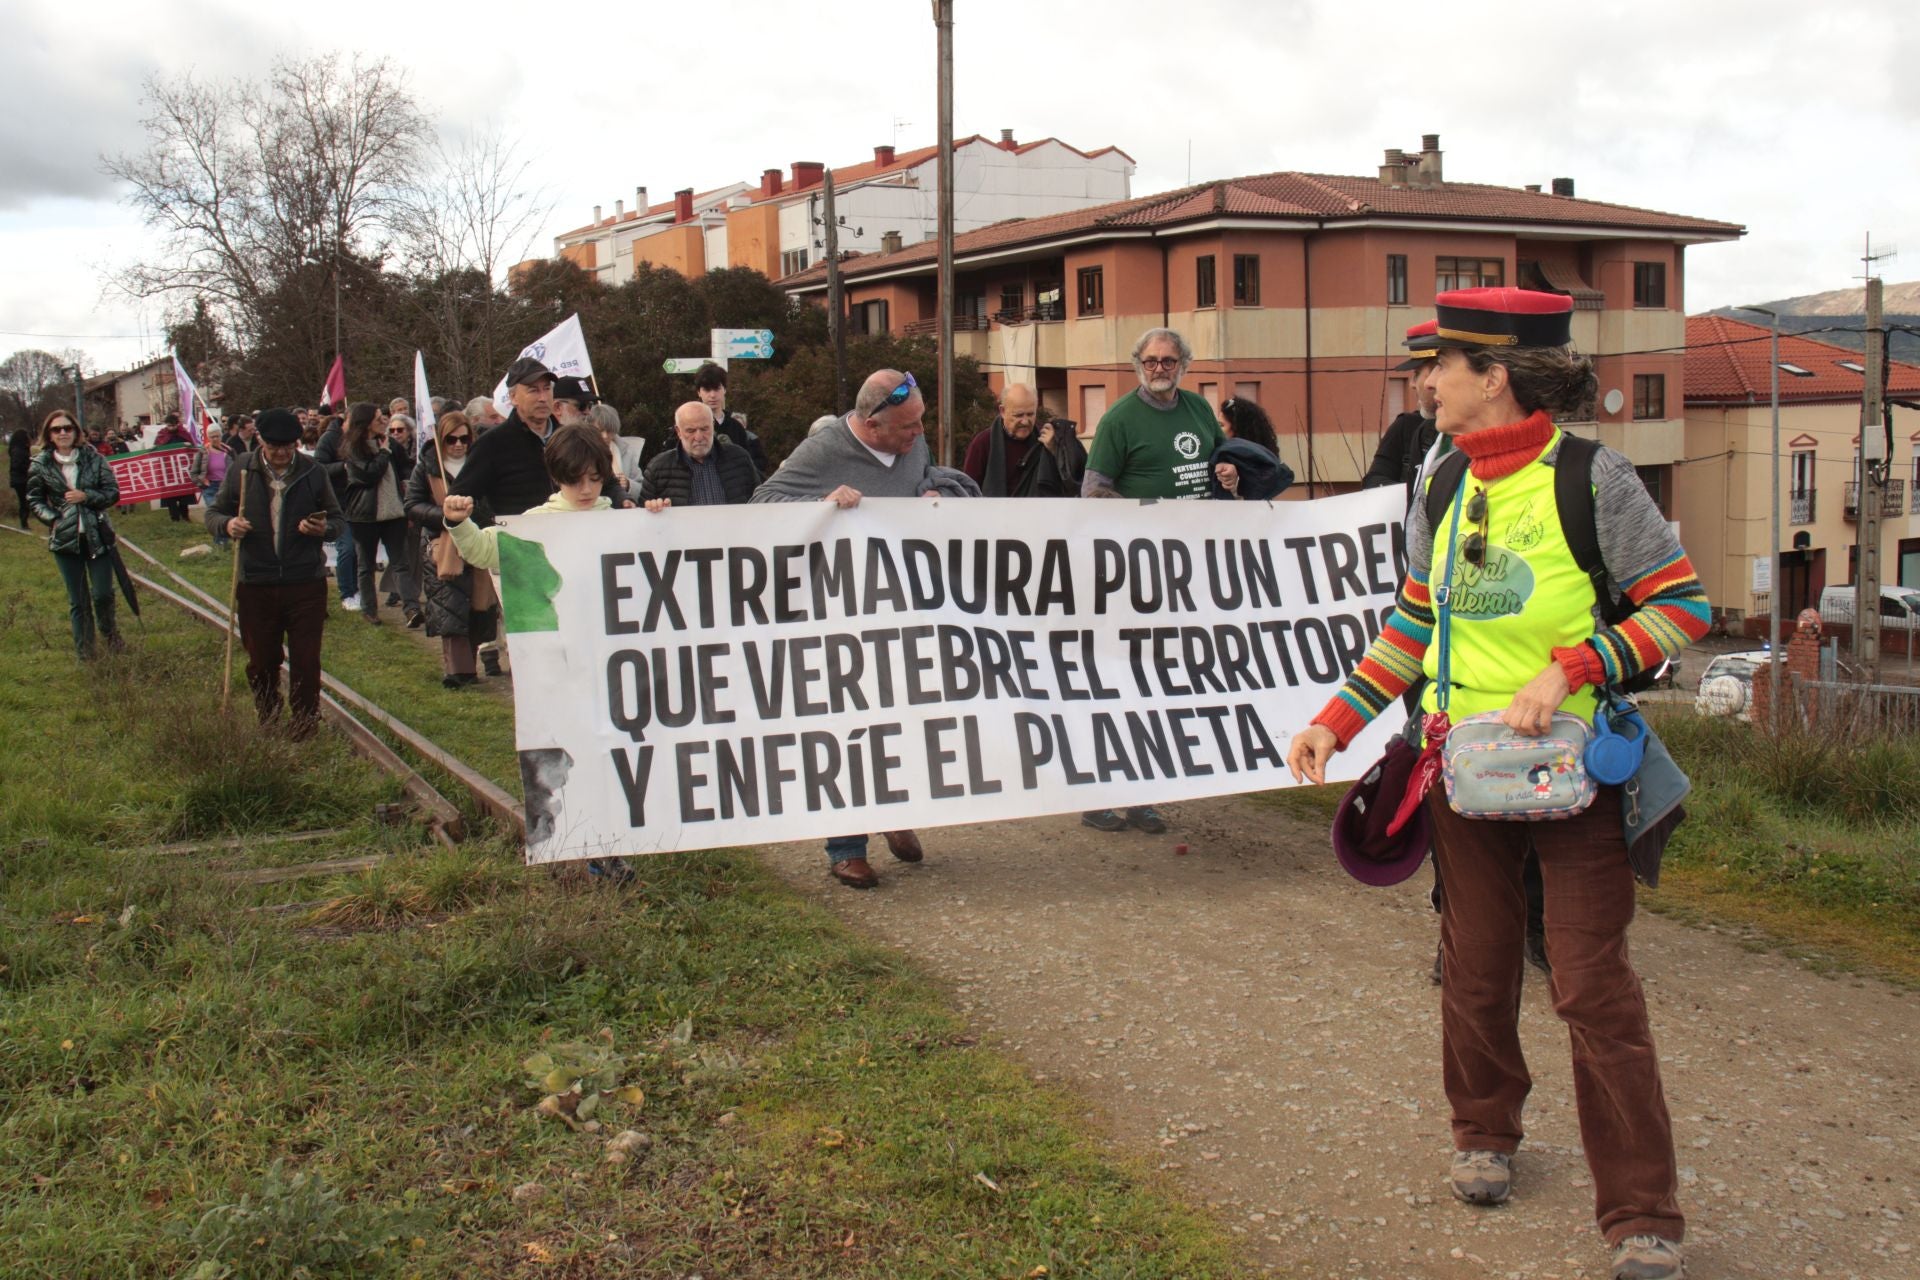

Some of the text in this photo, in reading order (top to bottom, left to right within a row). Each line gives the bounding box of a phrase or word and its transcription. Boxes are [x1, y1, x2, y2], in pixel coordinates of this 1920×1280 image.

[601, 538, 1076, 635] EXTREMADURA
[1094, 538, 1197, 615] POR
[1205, 538, 1282, 611] UN
[607, 605, 1397, 742] QUE VERTEBRE EL TERRITORI
[611, 745, 654, 828] Y
[924, 715, 1002, 799] EL
[1014, 704, 1284, 790] PLANETA
